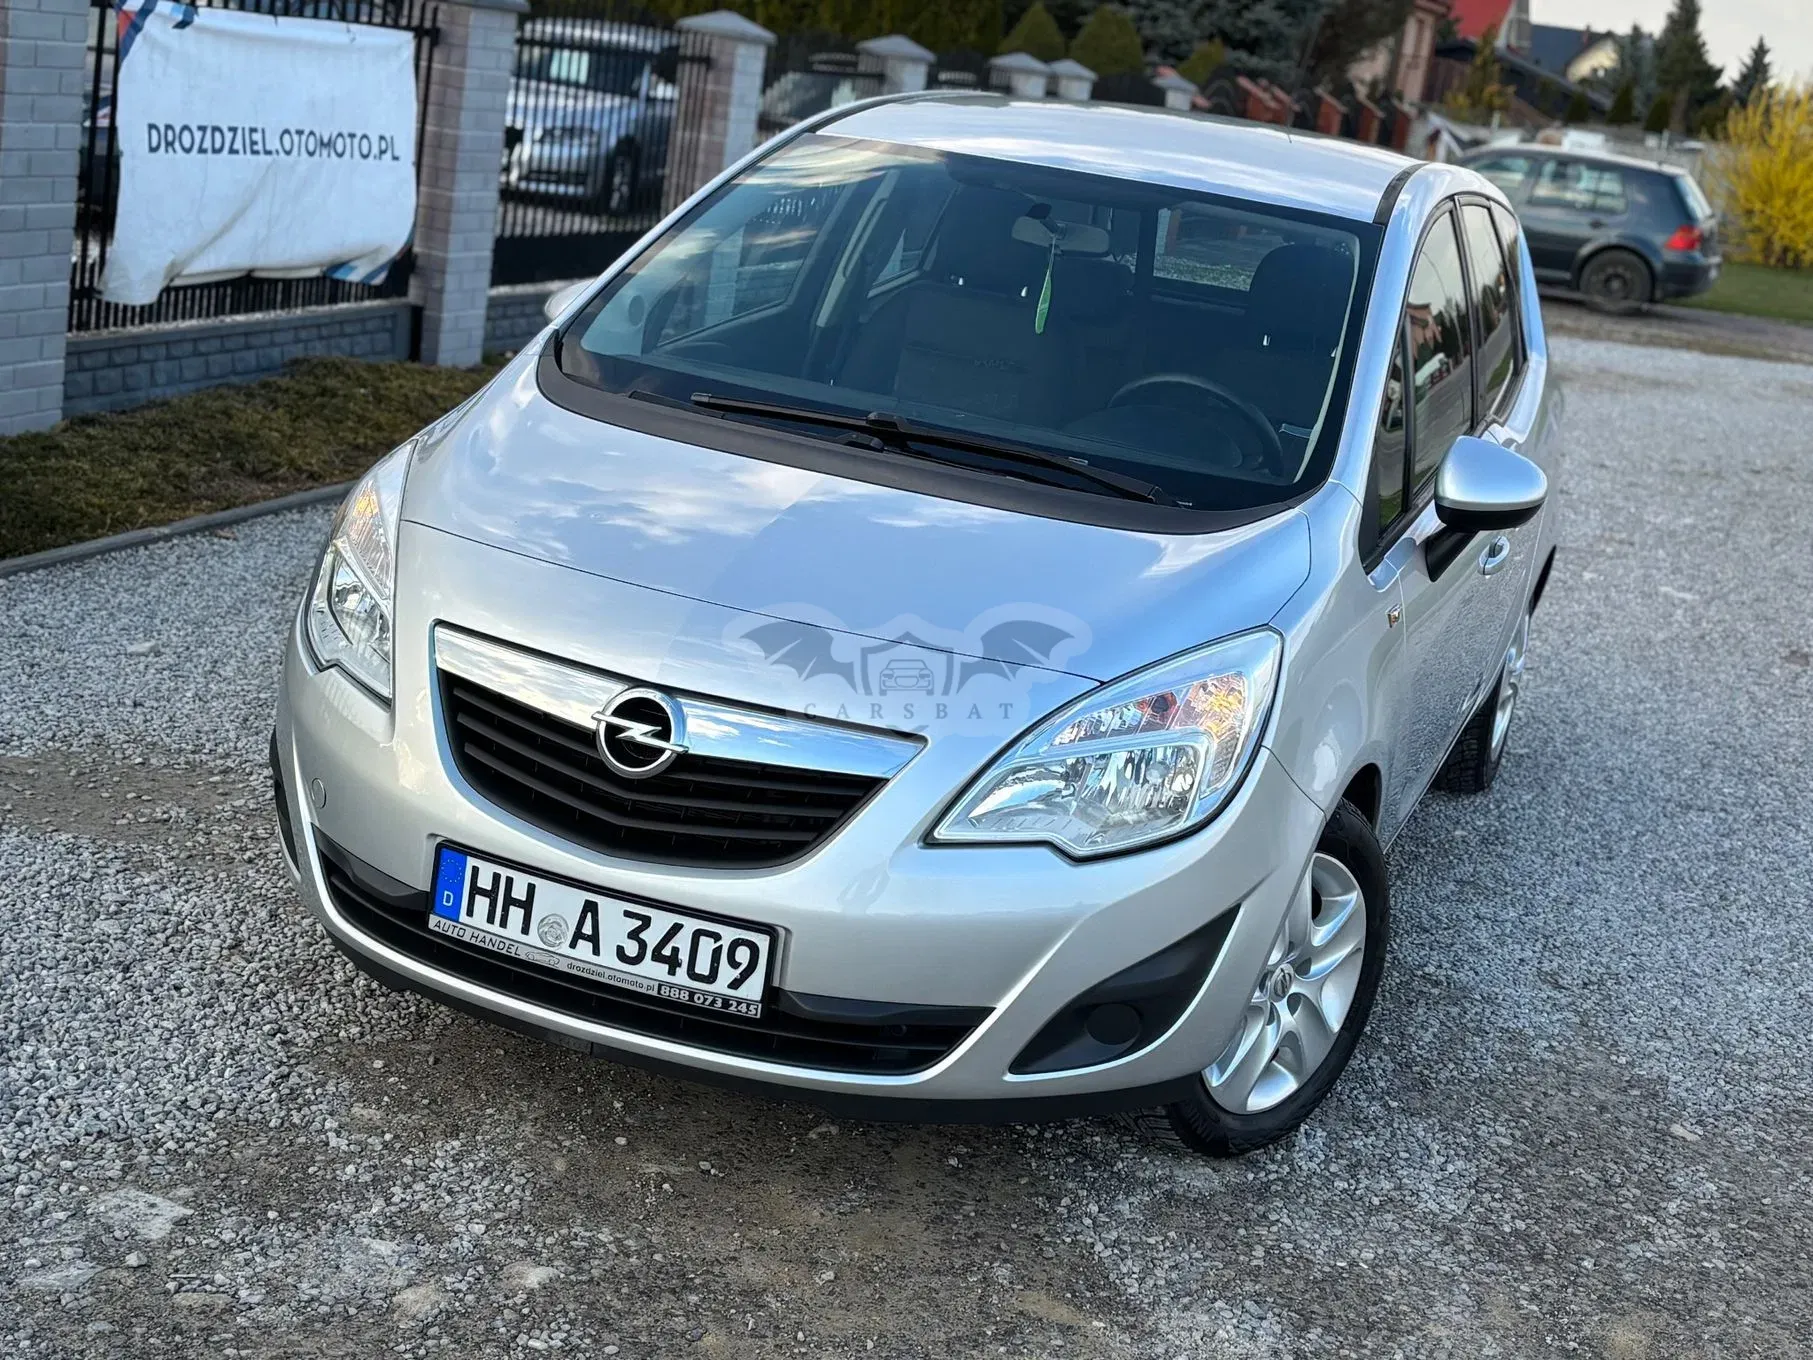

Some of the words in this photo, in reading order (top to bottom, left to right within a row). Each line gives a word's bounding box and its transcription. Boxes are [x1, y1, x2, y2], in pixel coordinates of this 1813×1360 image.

[147, 122, 400, 161] DROZDZIEL.OTOMOTO.PL
[442, 890, 455, 907] D
[433, 919, 467, 938] AUTO
[469, 931, 522, 957] HANDEL
[465, 865, 536, 936] HH
[568, 898, 600, 957] A
[615, 909, 760, 991] 3409
[660, 986, 690, 1001] 888
[693, 993, 723, 1009] 073
[727, 1000, 759, 1017] 245
